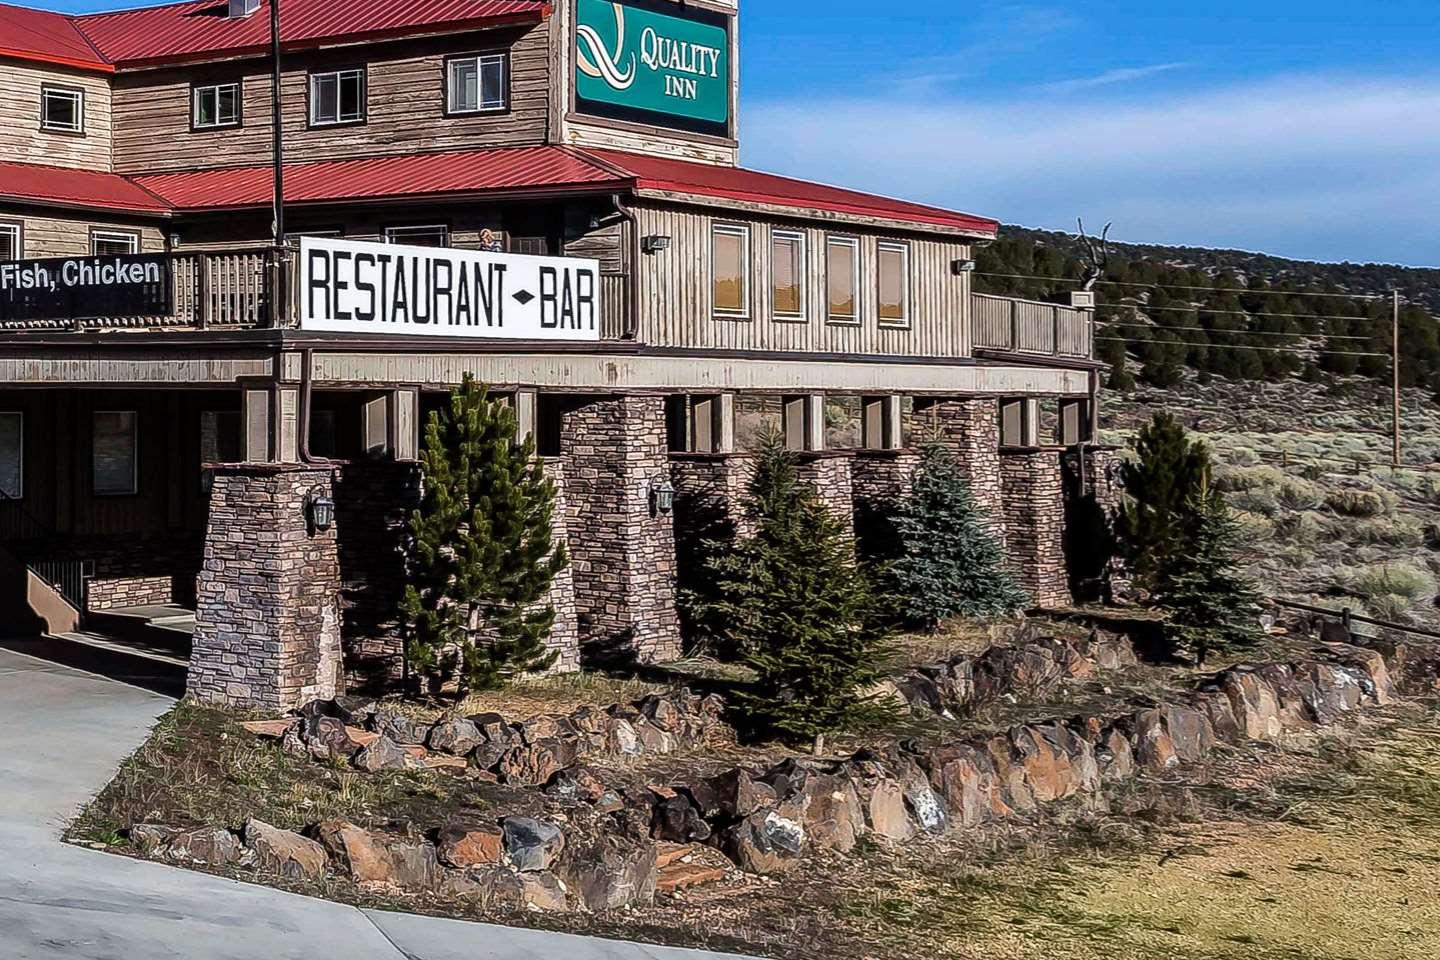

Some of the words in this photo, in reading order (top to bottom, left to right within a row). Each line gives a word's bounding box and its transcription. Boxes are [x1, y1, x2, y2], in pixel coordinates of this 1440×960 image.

[641, 27, 721, 77] QUALITY
[664, 74, 697, 100] INN
[0, 263, 56, 292] Fish,
[62, 259, 160, 287] Chicken
[308, 248, 507, 328] RESTAURANT
[539, 266, 595, 330] BAR
